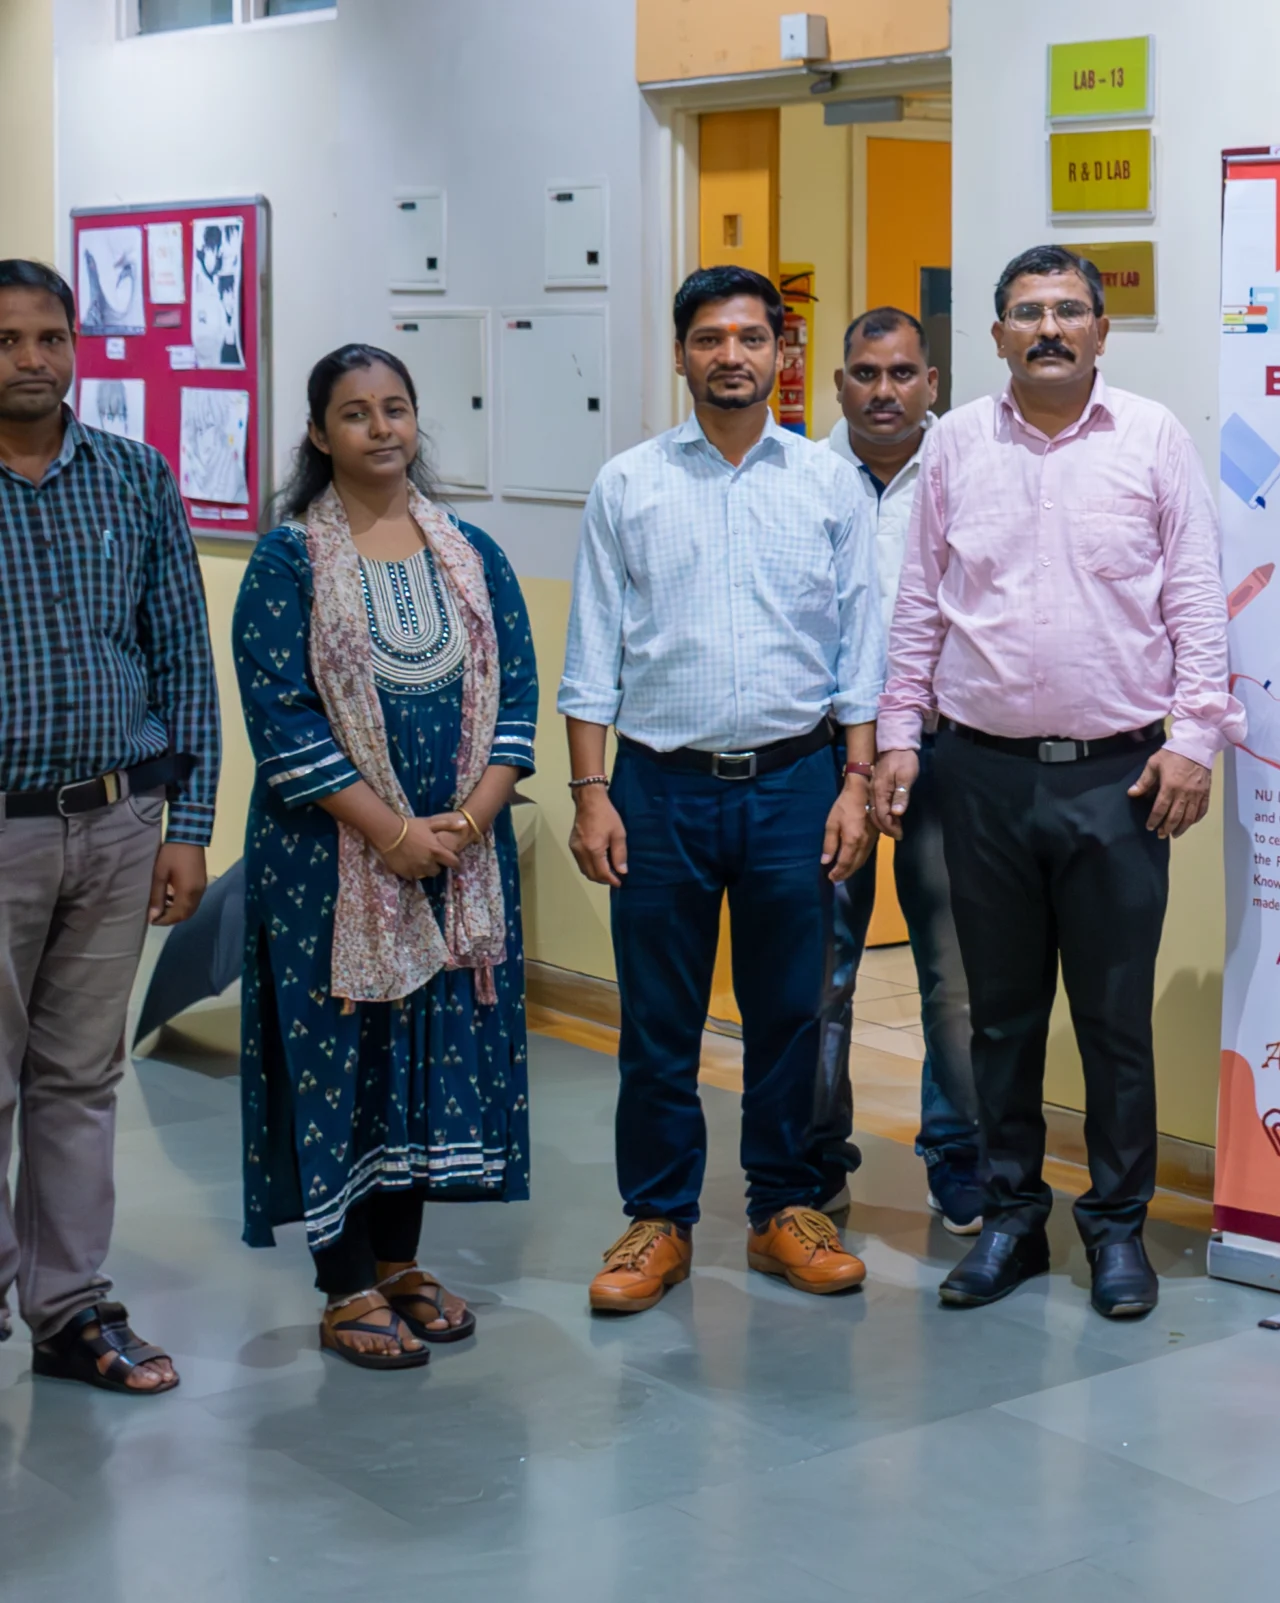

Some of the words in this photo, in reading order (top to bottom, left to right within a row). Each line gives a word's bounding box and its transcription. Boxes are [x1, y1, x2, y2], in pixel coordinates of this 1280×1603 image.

[1073, 70, 1096, 91] LAB
[1110, 68, 1125, 88] 13
[1069, 162, 1077, 182] R
[1081, 162, 1090, 181] &
[1094, 161, 1102, 181] D
[1107, 160, 1131, 180] LAB
[1120, 271, 1140, 288] LAB
[1255, 789, 1273, 802] NU
[1255, 812, 1275, 824] and
[1254, 833, 1266, 844] to
[1254, 853, 1271, 866] the
[1253, 897, 1280, 911] made
